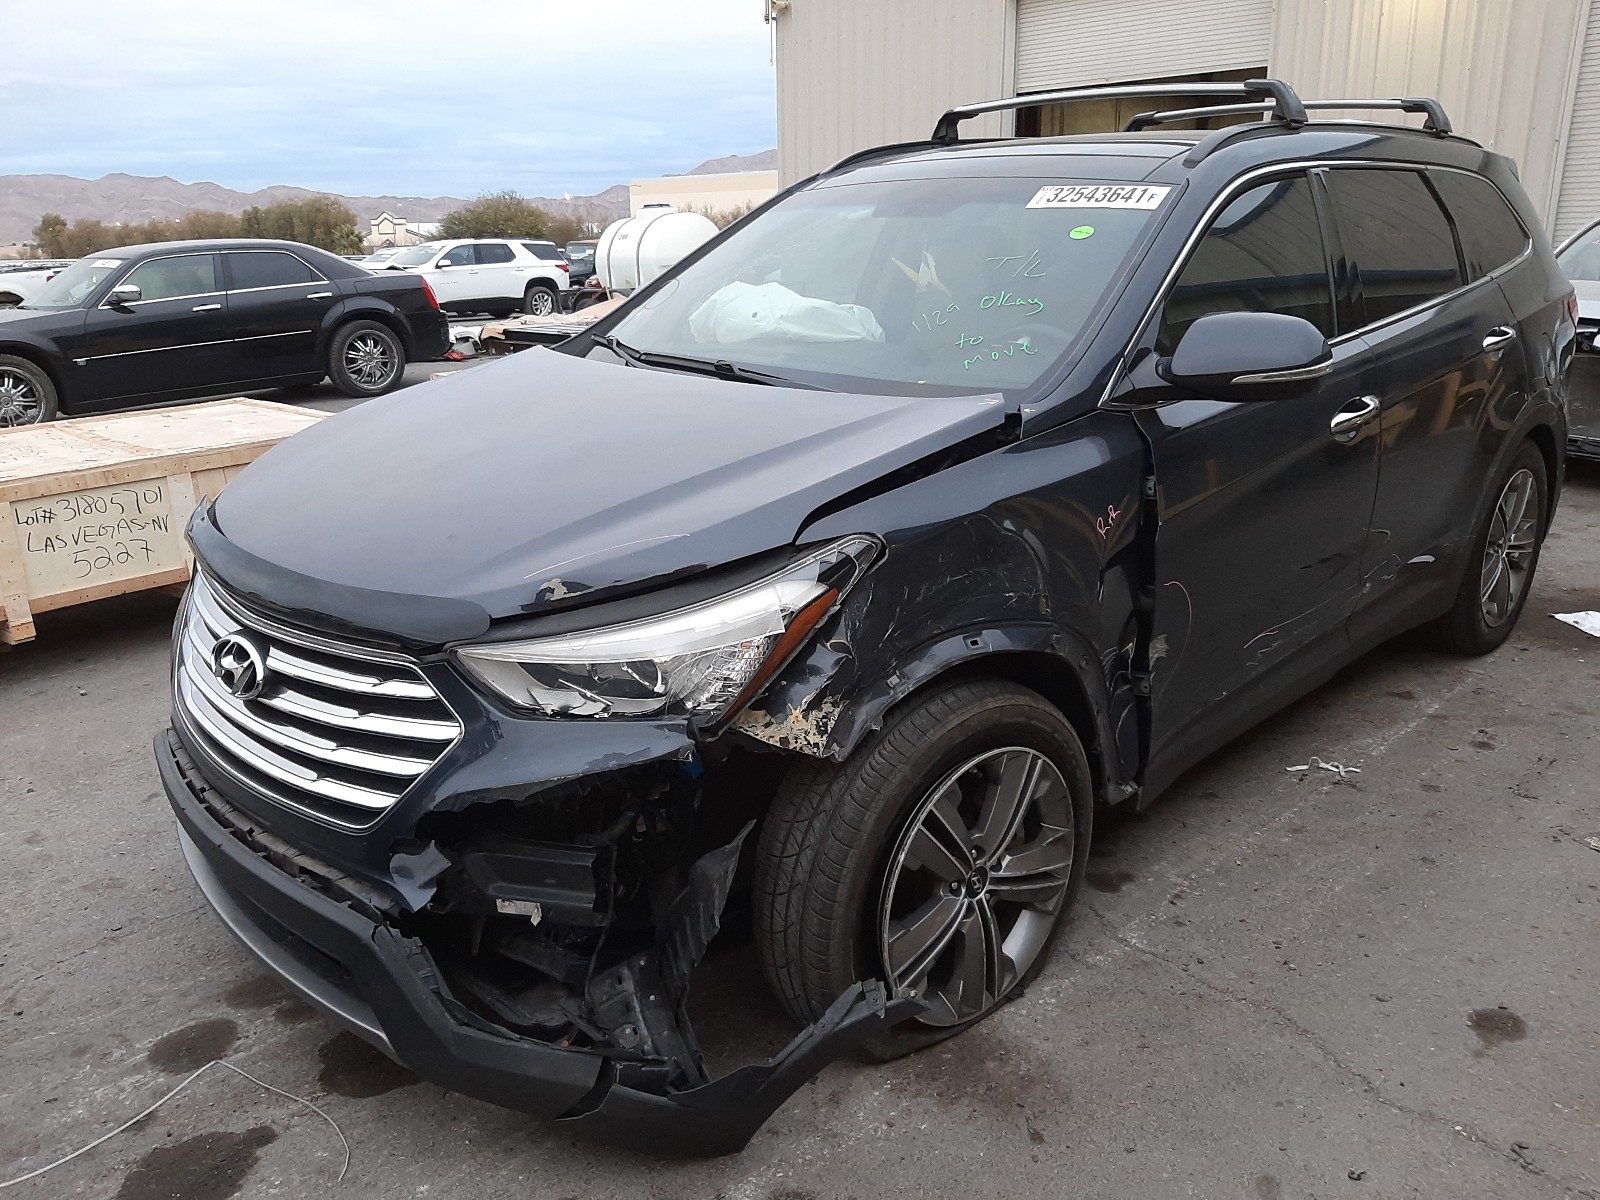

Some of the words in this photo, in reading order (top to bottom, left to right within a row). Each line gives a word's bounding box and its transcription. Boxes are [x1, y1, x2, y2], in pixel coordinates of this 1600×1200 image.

[1046, 186, 1150, 204] 32543641
[56, 486, 163, 521] 31805701
[27, 532, 68, 553] LAS
[73, 539, 155, 579] 5227
